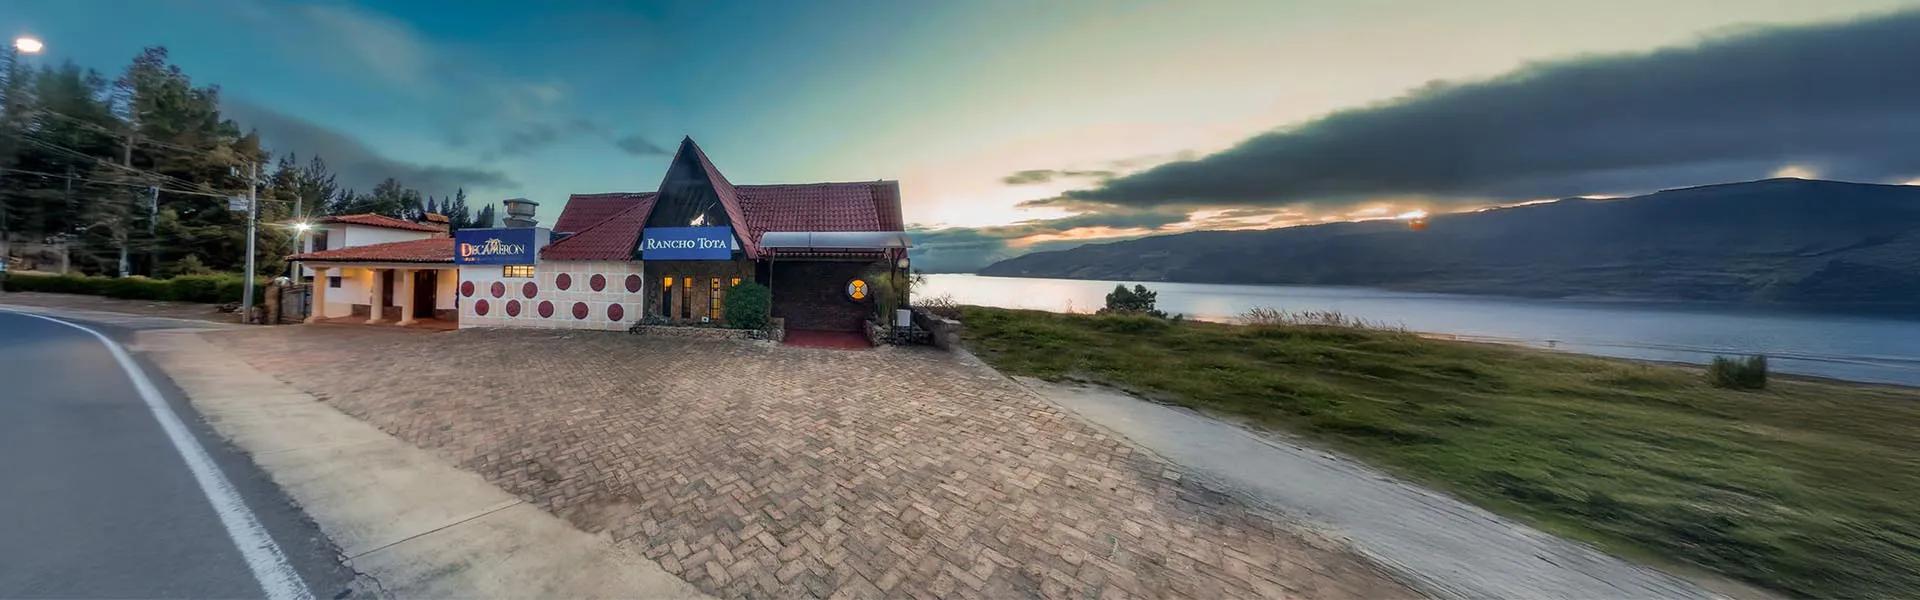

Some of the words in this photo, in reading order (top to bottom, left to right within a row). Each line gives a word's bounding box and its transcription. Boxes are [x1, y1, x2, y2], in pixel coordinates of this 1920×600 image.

[461, 238, 525, 257] DECAMERON
[647, 238, 696, 250] RANCHO
[697, 237, 727, 249] TOTA
